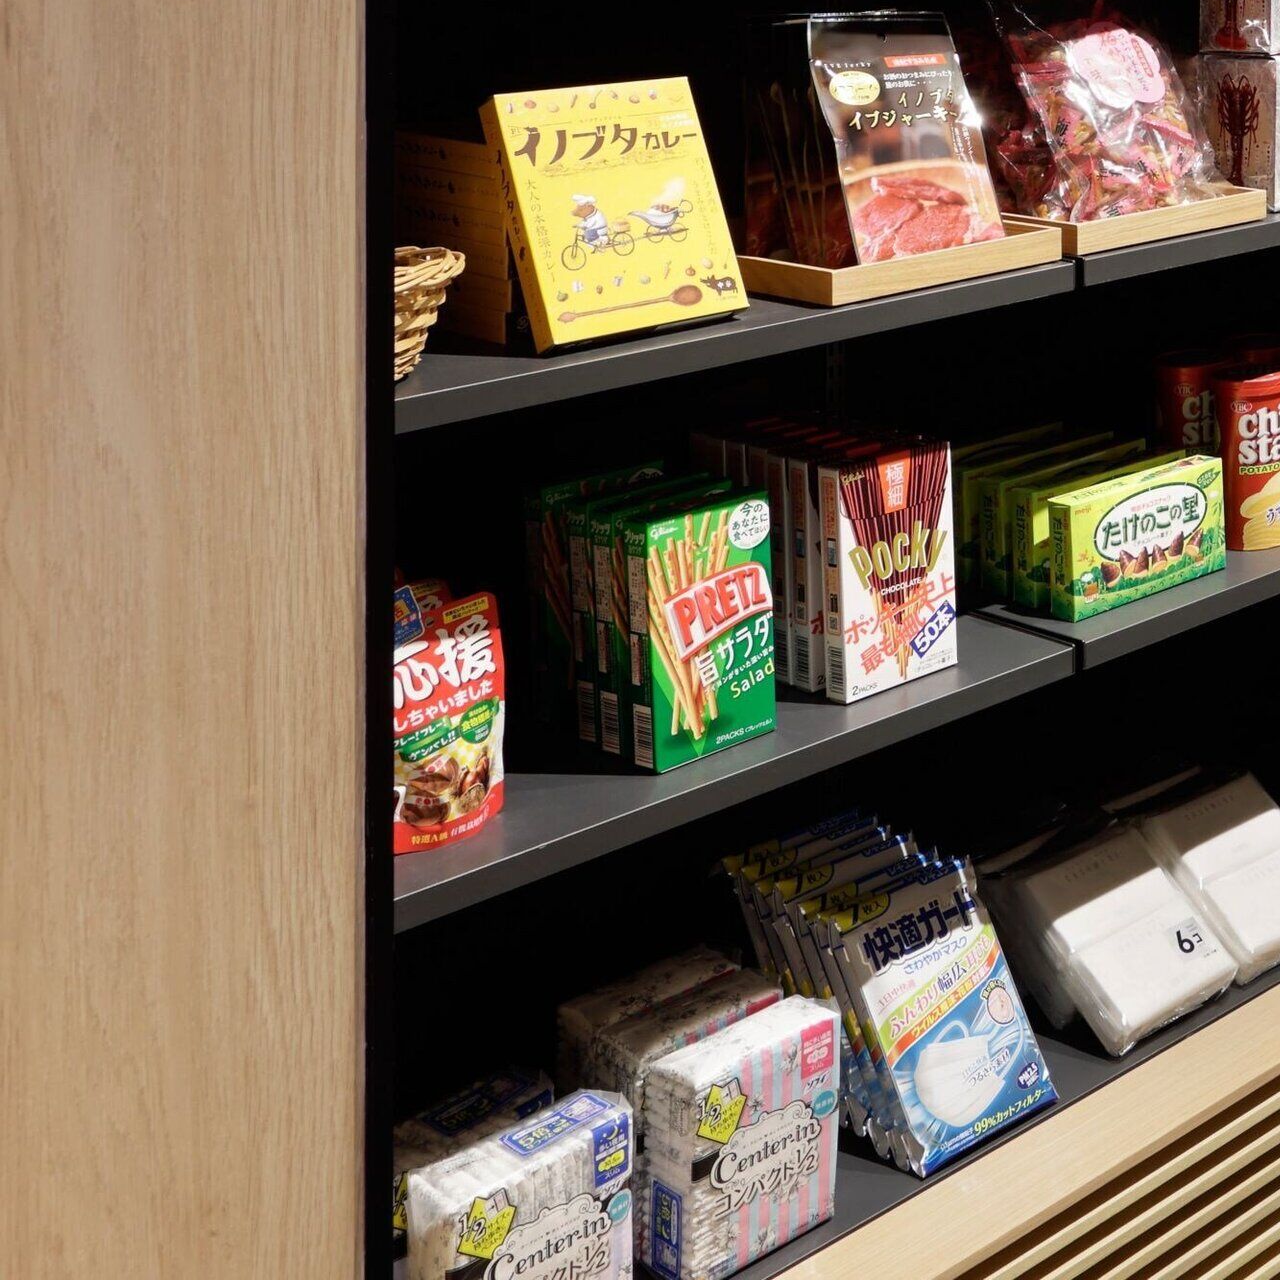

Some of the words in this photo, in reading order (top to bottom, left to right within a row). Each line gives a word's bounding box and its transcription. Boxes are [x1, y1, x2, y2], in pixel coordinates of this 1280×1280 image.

[514, 123, 698, 168] イノブタカレー
[885, 463, 905, 508] 極細
[1239, 464, 1280, 476] POTATO
[731, 514, 769, 531] あなたに
[740, 502, 763, 517] 今の
[1101, 492, 1200, 550] たけのこの里
[671, 565, 768, 649] PRETZ
[880, 576, 923, 597] CHOCOLATE
[730, 661, 776, 699] Salad
[715, 727, 745, 746] 2PACKS
[861, 886, 979, 970] 快適ガード
[903, 934, 969, 975] さわやかマスク
[715, 1117, 819, 1184] Center-in
[494, 1214, 607, 1278] Center-in
[584, 1239, 606, 1269] 1/2
